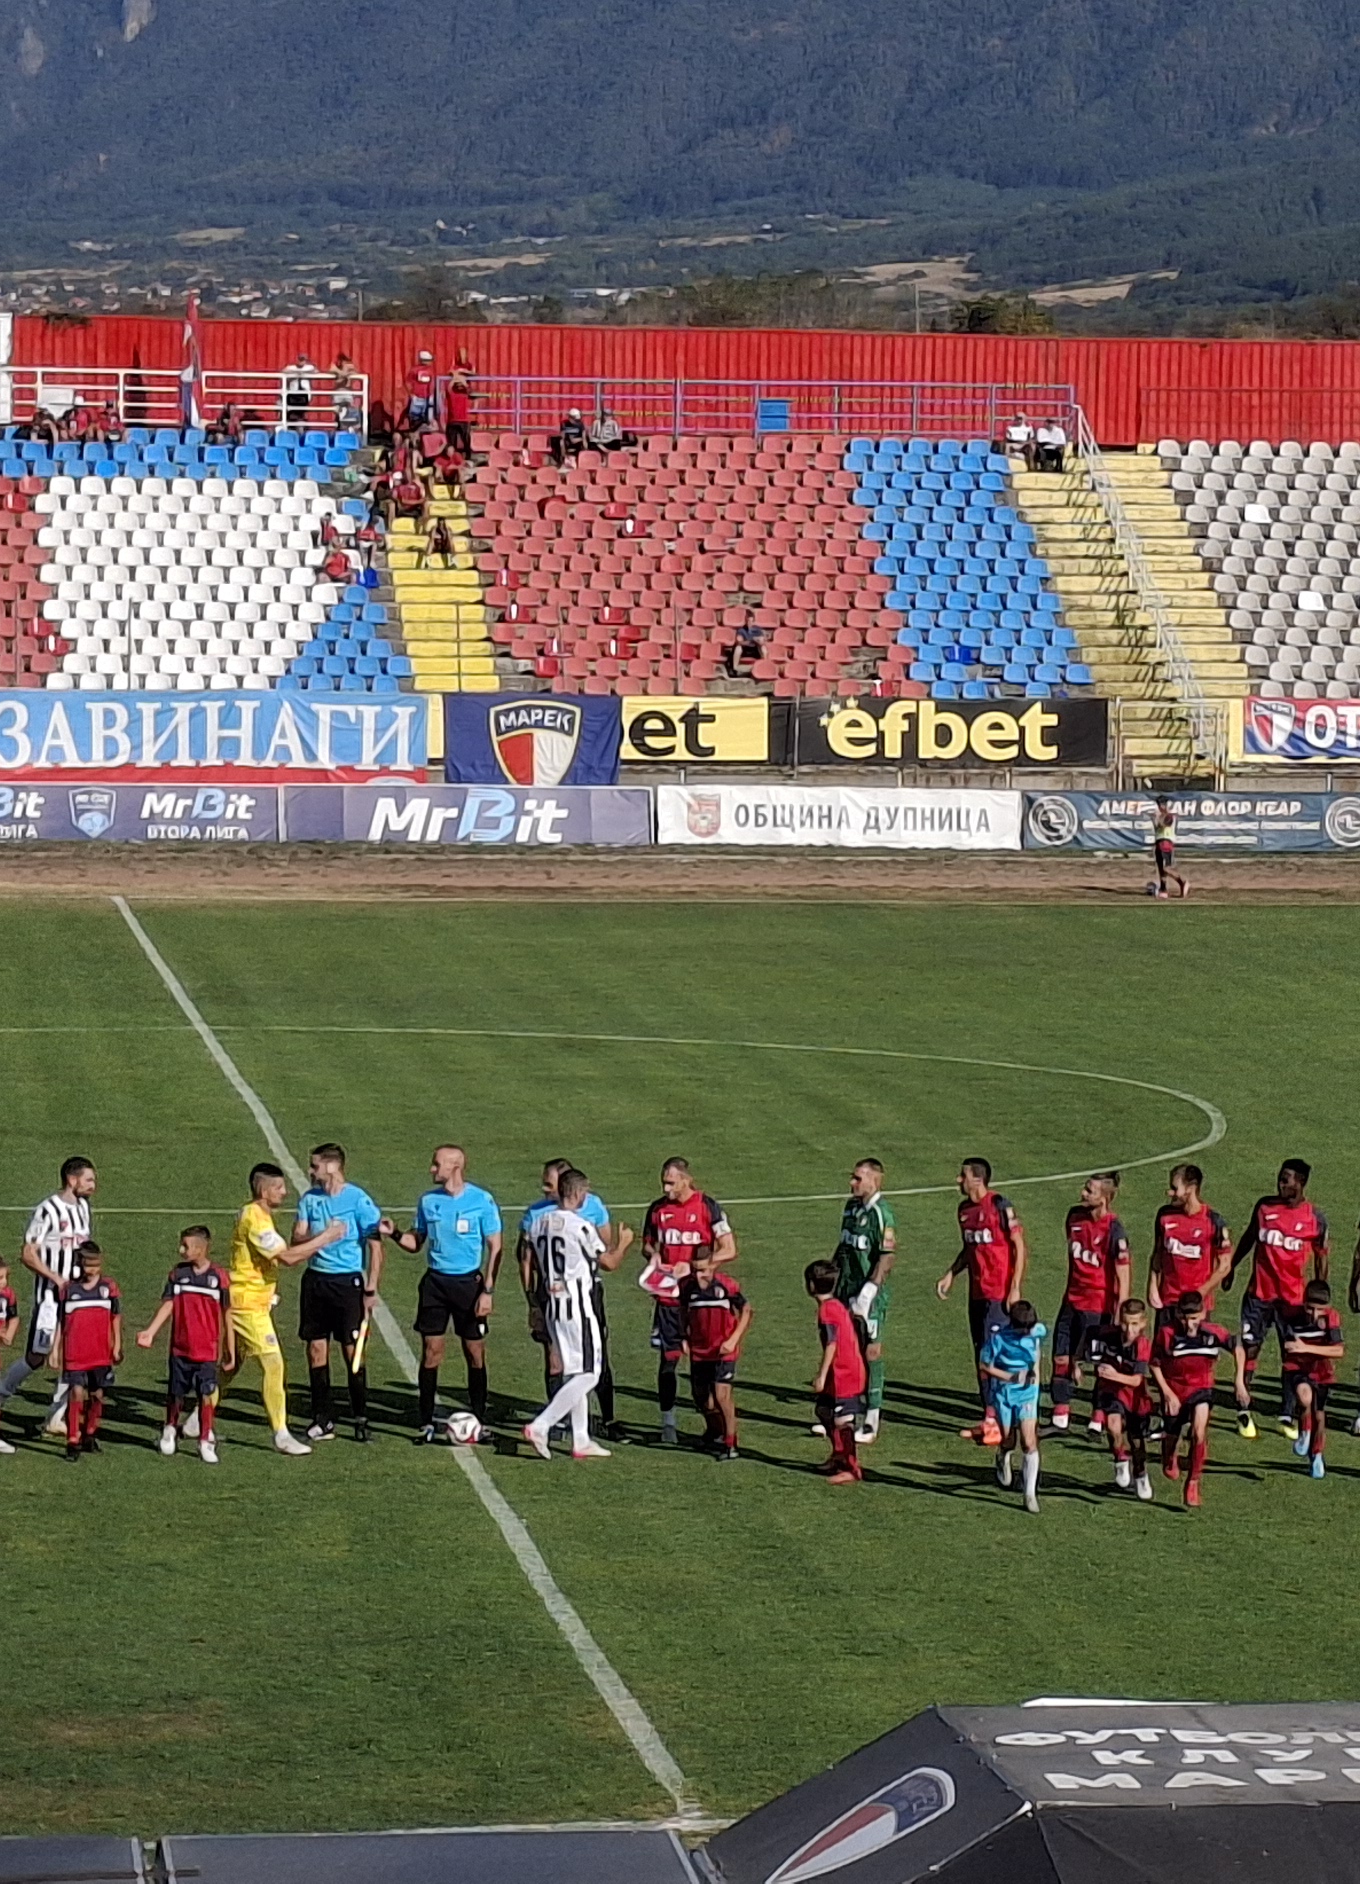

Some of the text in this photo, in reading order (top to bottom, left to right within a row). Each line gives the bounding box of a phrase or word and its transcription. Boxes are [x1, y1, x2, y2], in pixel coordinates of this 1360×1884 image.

[498, 709, 574, 732] МАРЕК
[826, 700, 1059, 761] efbet
[140, 788, 256, 820] MrBit
[368, 787, 569, 843] MrBit
[734, 802, 991, 835] ОБЩИНА ДУПНИЦА
[204, 826, 248, 840] ЛИГА
